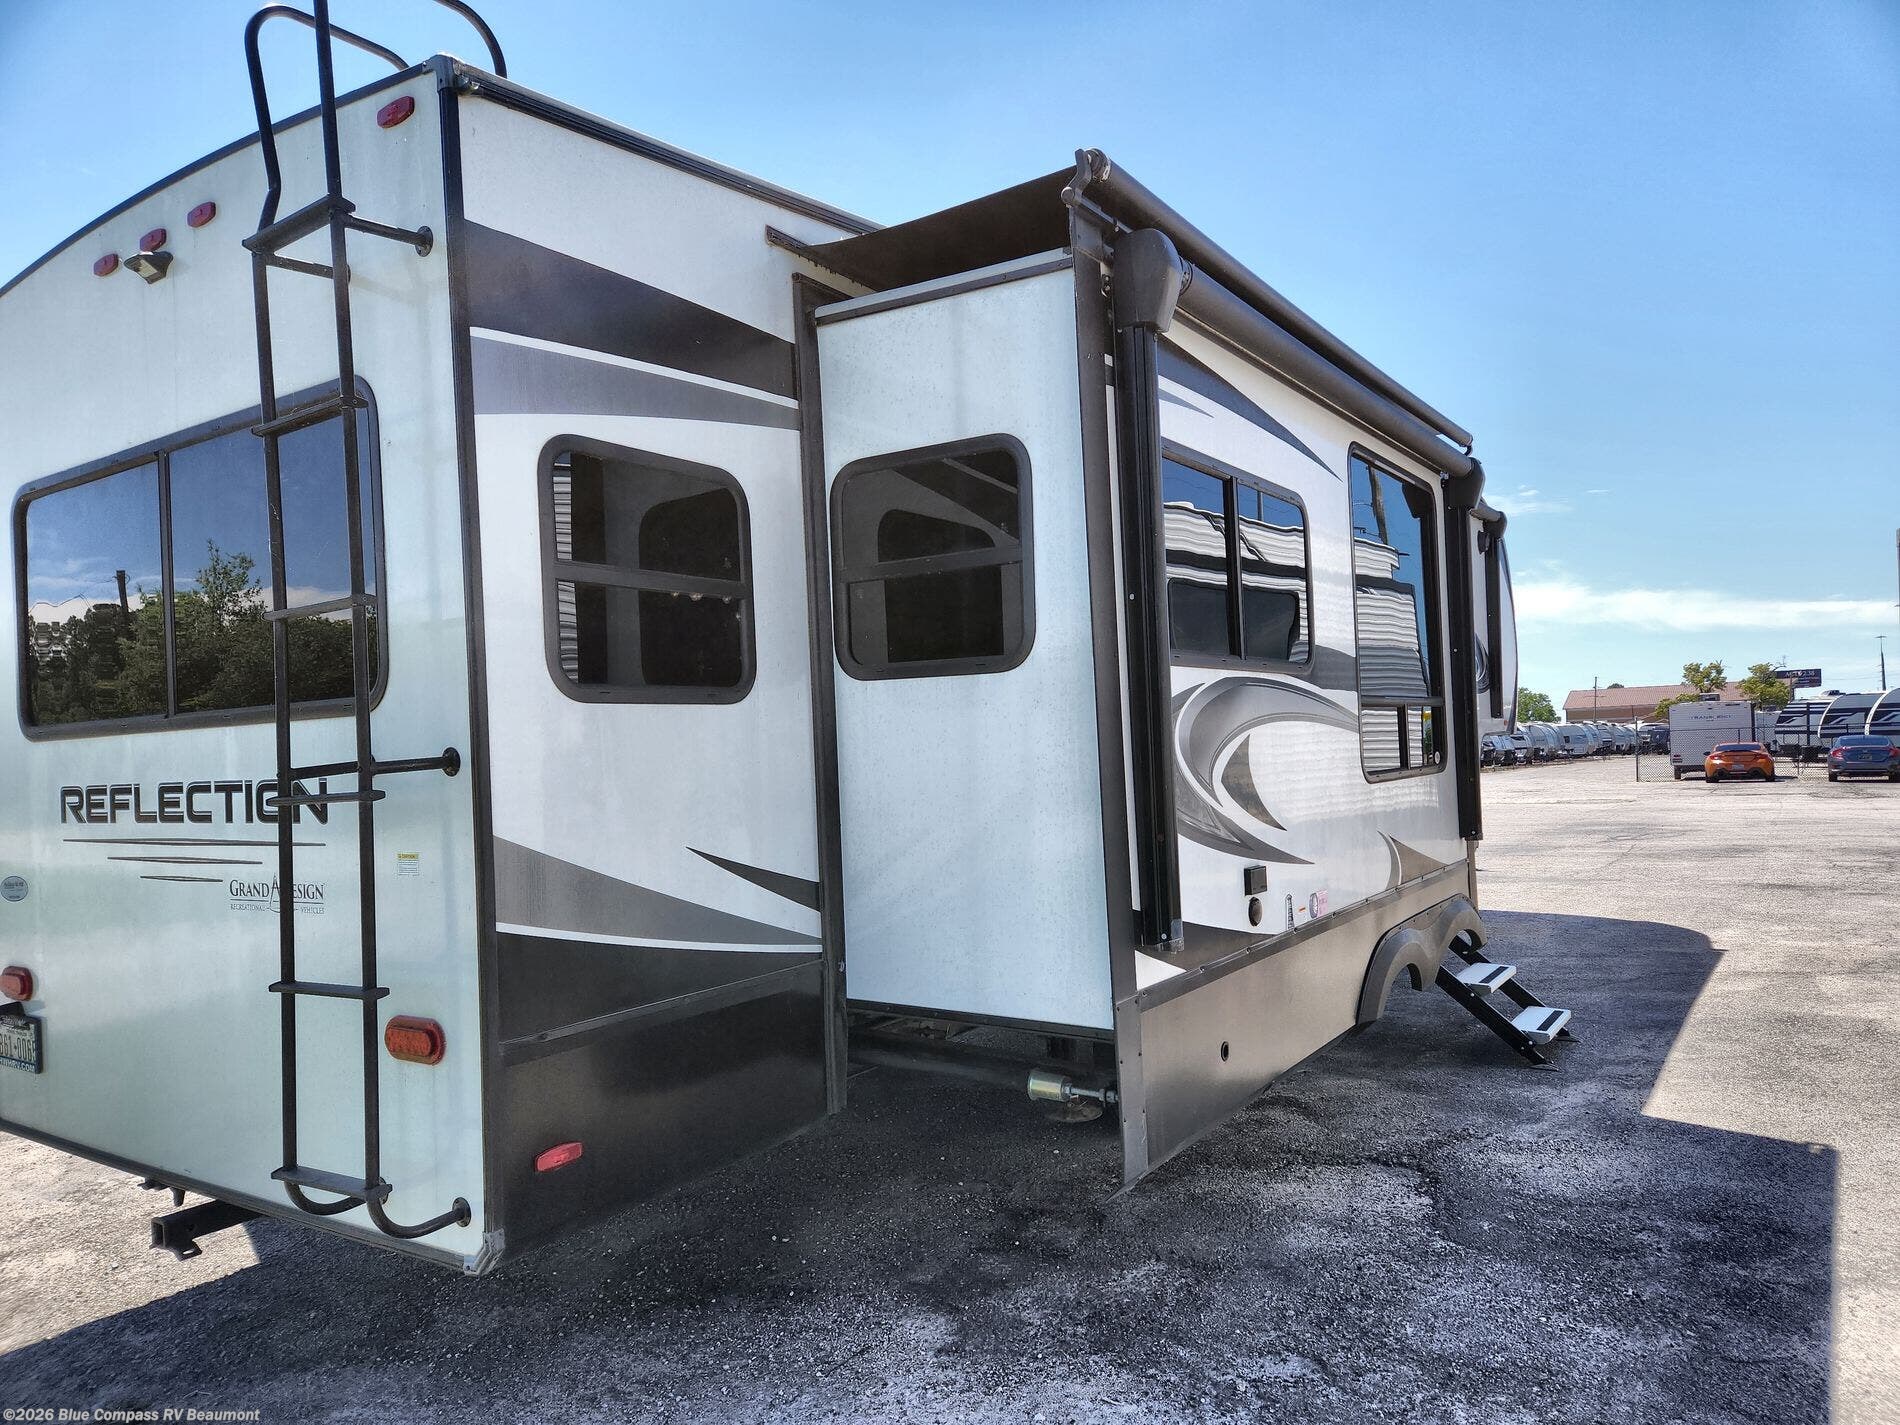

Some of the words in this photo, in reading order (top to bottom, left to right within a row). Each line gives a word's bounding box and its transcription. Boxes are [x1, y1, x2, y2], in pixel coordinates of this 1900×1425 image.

[60, 779, 329, 825] REFLECTION
[229, 879, 270, 898] GRAND
[291, 883, 324, 900] ESIGN
[300, 907, 325, 915] VEHICLES
